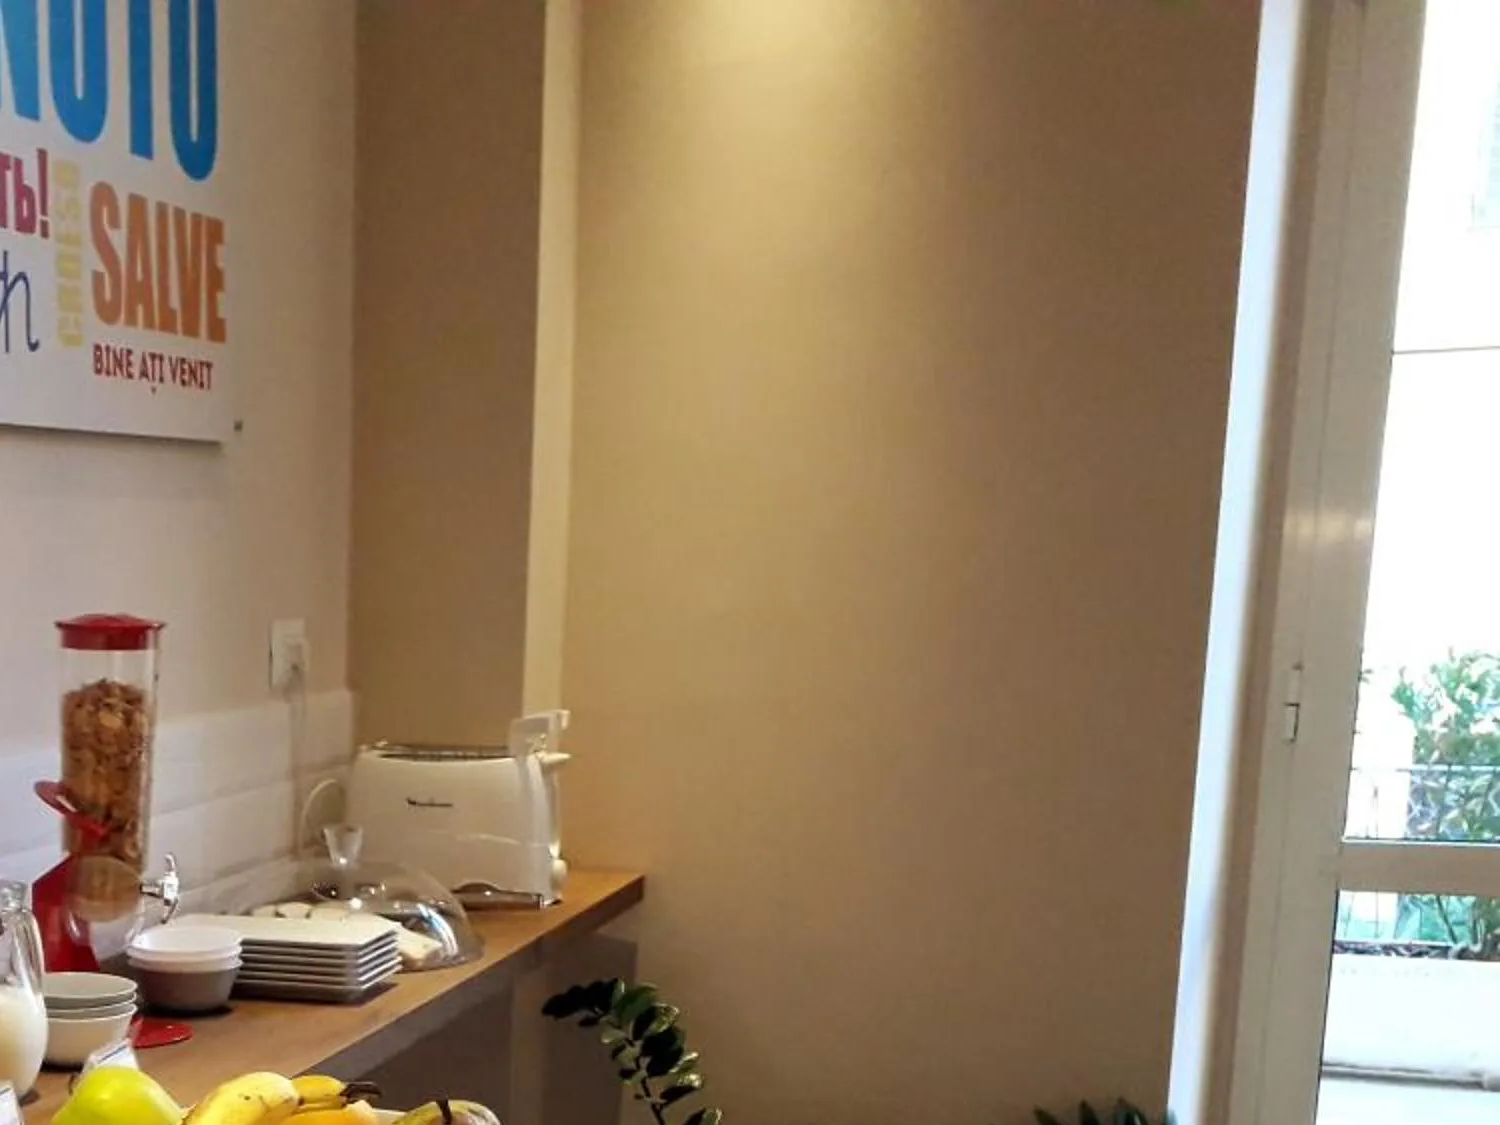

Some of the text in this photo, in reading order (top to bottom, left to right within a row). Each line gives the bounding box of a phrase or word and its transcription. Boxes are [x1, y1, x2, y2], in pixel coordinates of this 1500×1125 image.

[90, 181, 227, 344] SALVE
[93, 343, 134, 380] BINE
[169, 357, 213, 390] VENIT
